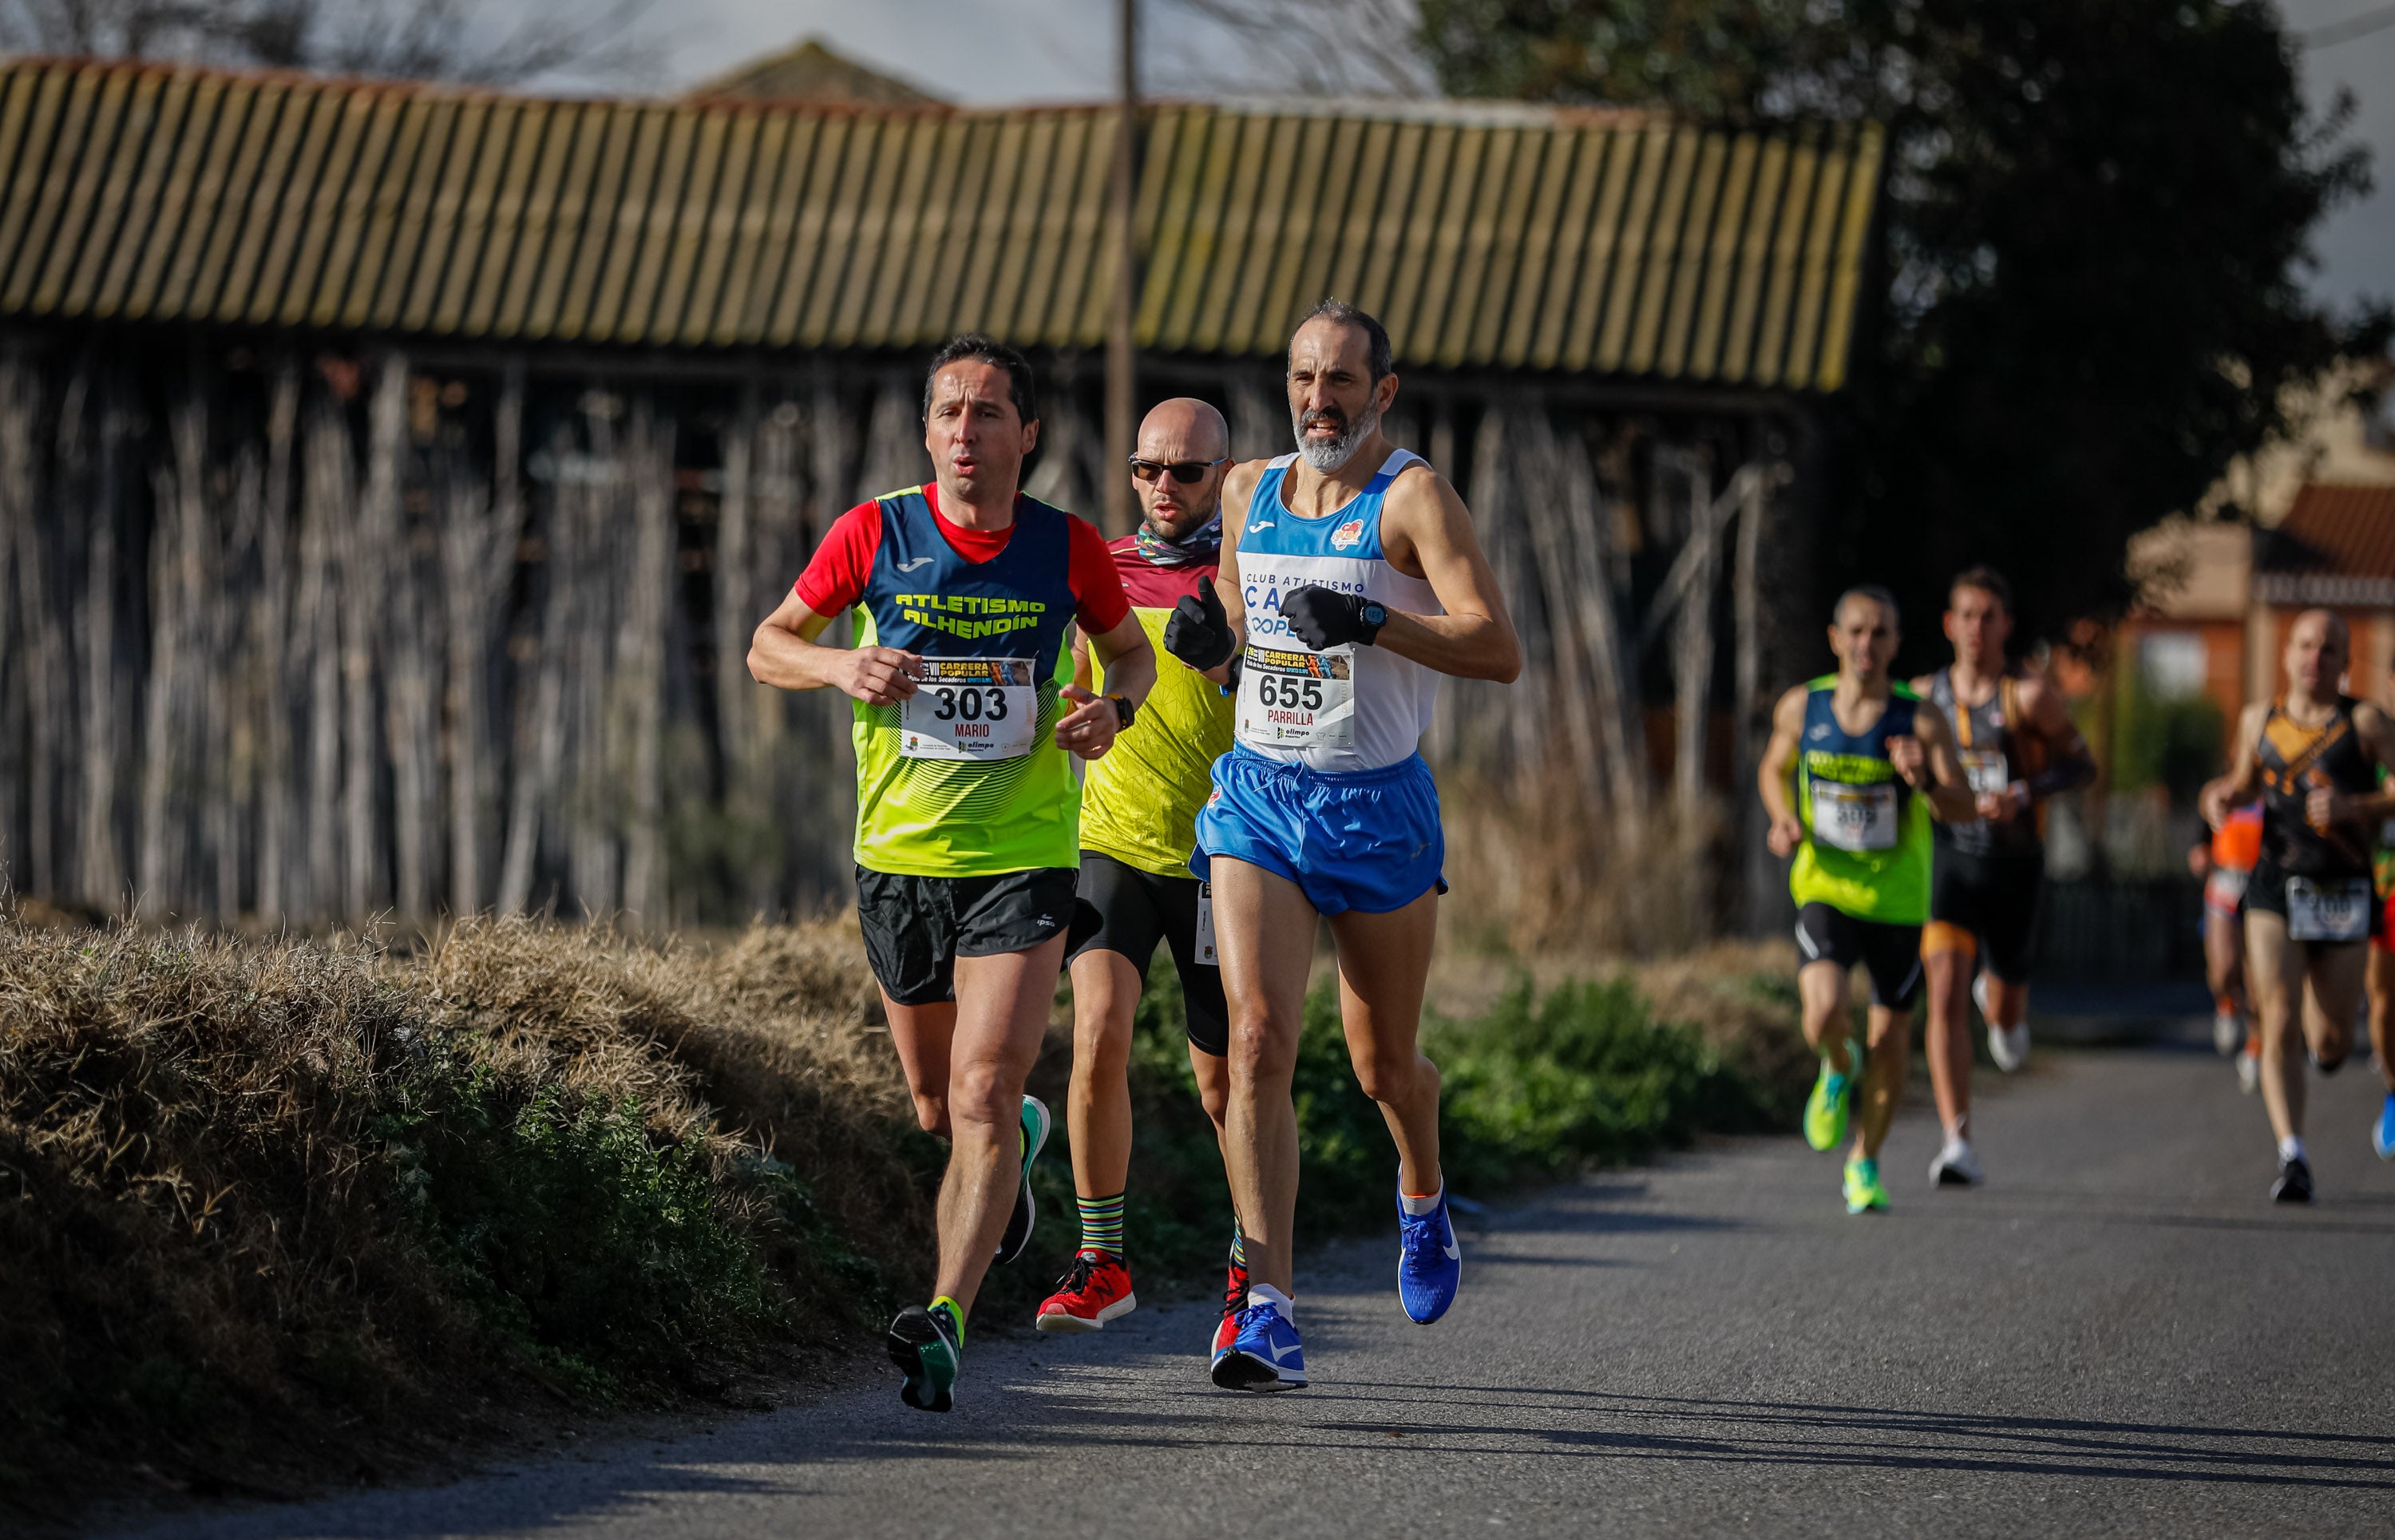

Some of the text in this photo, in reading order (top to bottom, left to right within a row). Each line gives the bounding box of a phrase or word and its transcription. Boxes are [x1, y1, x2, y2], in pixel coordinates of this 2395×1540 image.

[1246, 573, 1276, 584] CLUB
[895, 594, 1046, 615] ATLETISMO
[904, 608, 1038, 639] ALHENDÍN
[1265, 651, 1305, 662] CARRERA
[929, 662, 940, 676] VII
[940, 662, 988, 671] CARRERA
[1263, 663, 1285, 672] Secaderos
[1265, 658, 1305, 668] POPULAR
[1259, 675, 1323, 711] 655
[934, 687, 1008, 721] 303
[1268, 710, 1313, 726] PARRILLA
[955, 723, 990, 738] MARIO
[1286, 728, 1310, 737] olimpo
[968, 741, 995, 750] olimpo
